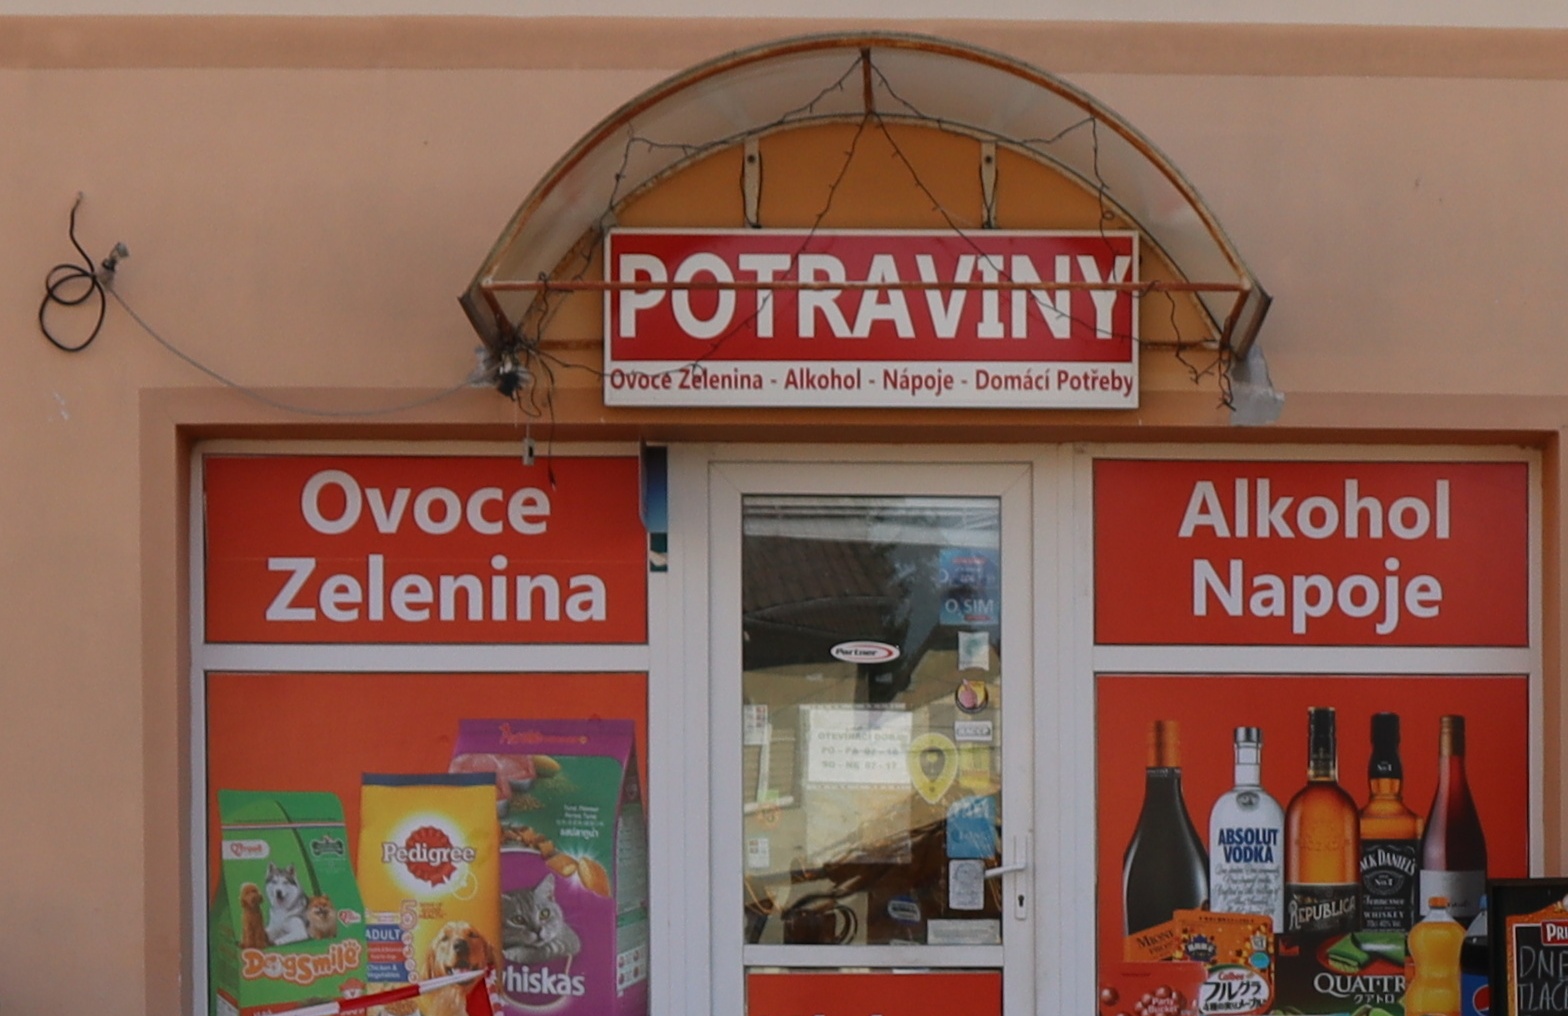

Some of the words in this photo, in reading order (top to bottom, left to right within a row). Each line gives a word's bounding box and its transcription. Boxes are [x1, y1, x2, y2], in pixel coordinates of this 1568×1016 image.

[619, 252, 1132, 340] POTRAVINY
[610, 369, 672, 390] Ovoce
[678, 368, 763, 390] Zelenina
[784, 369, 861, 391] Alkohol
[882, 368, 955, 397] Nápoje
[975, 369, 1050, 391] Domácí
[1056, 369, 1134, 397] Potřeby
[300, 469, 551, 535] Ovoce
[1177, 478, 1451, 540] Alkohol
[265, 553, 607, 622] Zelenina
[1193, 557, 1443, 634] Napoje
[1218, 828, 1279, 846] ABSOLUT
[381, 843, 477, 866] Pedigree
[1223, 845, 1274, 863] VODKA
[1288, 895, 1357, 931] REPUBLICA
[364, 928, 401, 940] ADULT
[1203, 981, 1262, 1001] フルグラ
